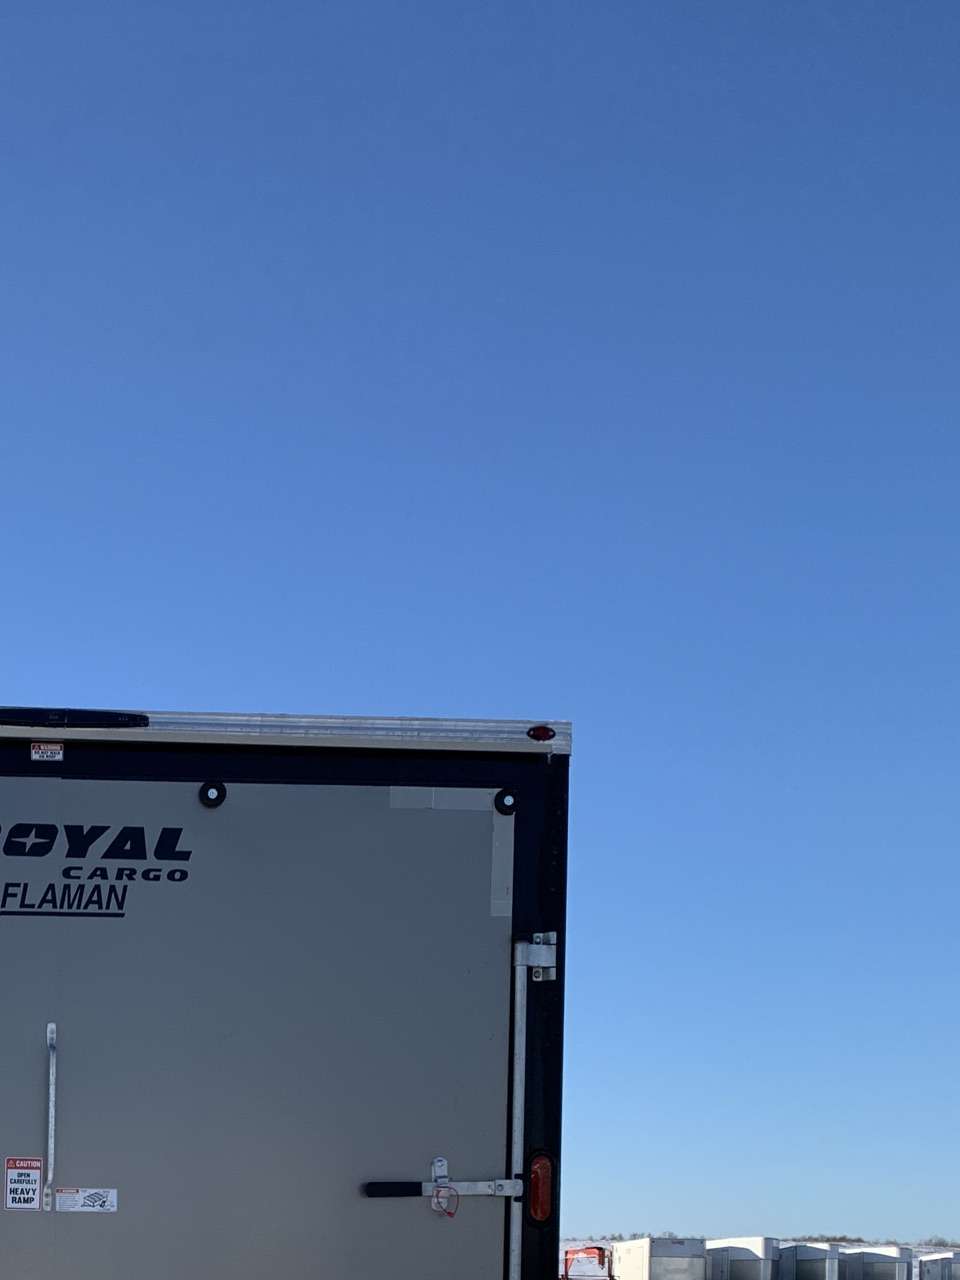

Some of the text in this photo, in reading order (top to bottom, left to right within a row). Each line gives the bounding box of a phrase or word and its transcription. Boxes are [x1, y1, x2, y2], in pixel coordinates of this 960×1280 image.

[61, 866, 189, 882] CARGO
[0, 882, 128, 910] FLAMAN
[15, 1160, 41, 1168] CAUTION
[9, 1187, 37, 1196] HEAVY
[11, 1196, 35, 1204] RAMP
